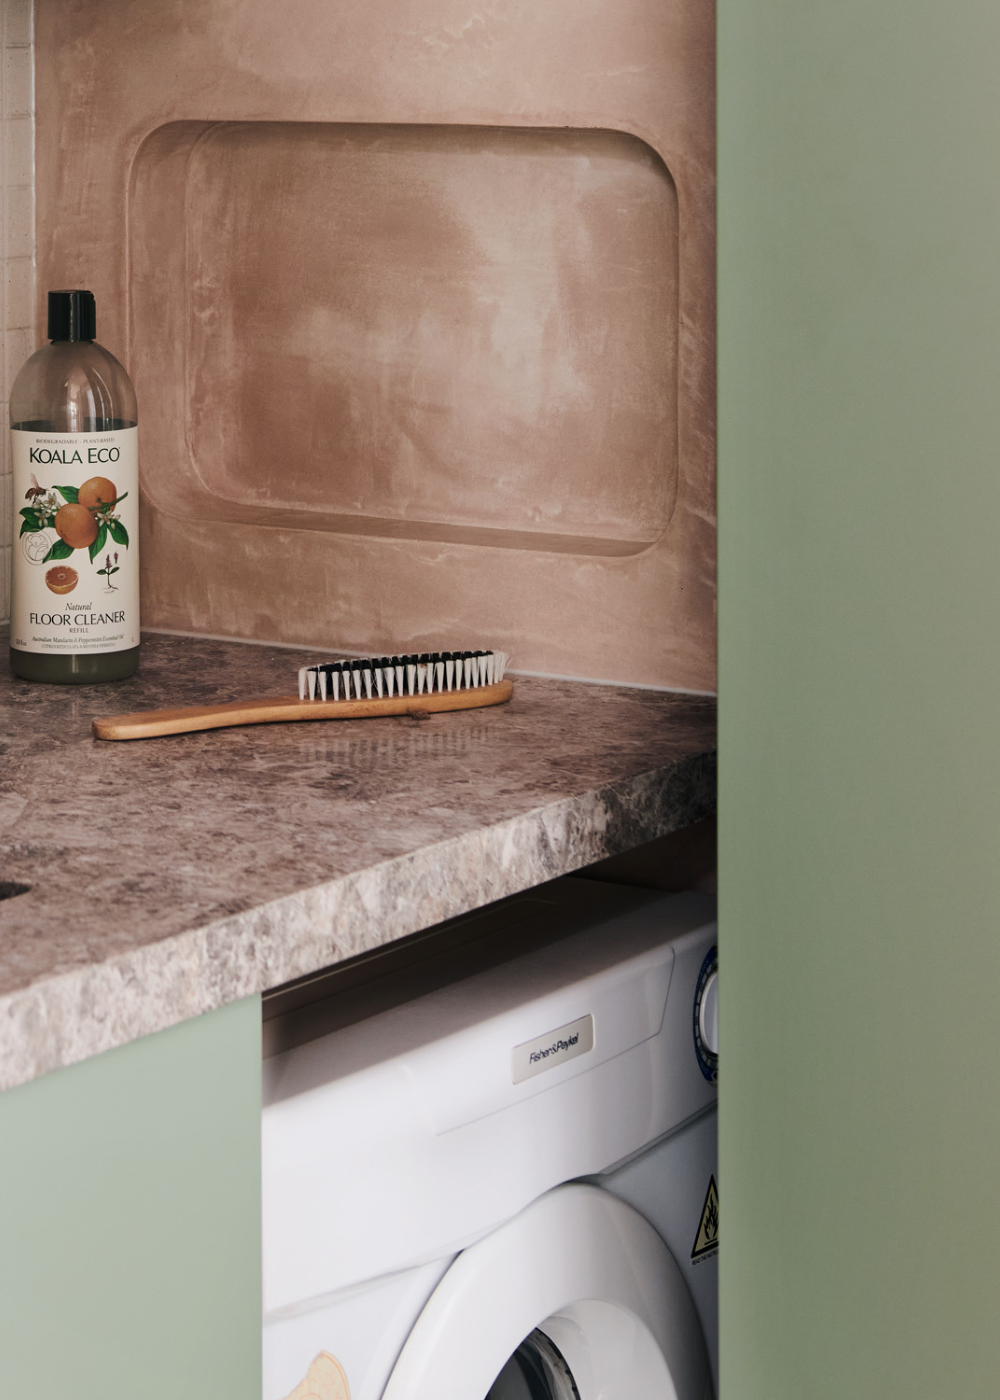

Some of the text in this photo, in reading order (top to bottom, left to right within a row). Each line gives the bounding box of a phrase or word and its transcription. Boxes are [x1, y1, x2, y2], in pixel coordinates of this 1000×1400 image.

[29, 447, 120, 464] KOALA ECO
[65, 602, 92, 611] Natural
[29, 610, 126, 626] FLOOR CLEANER
